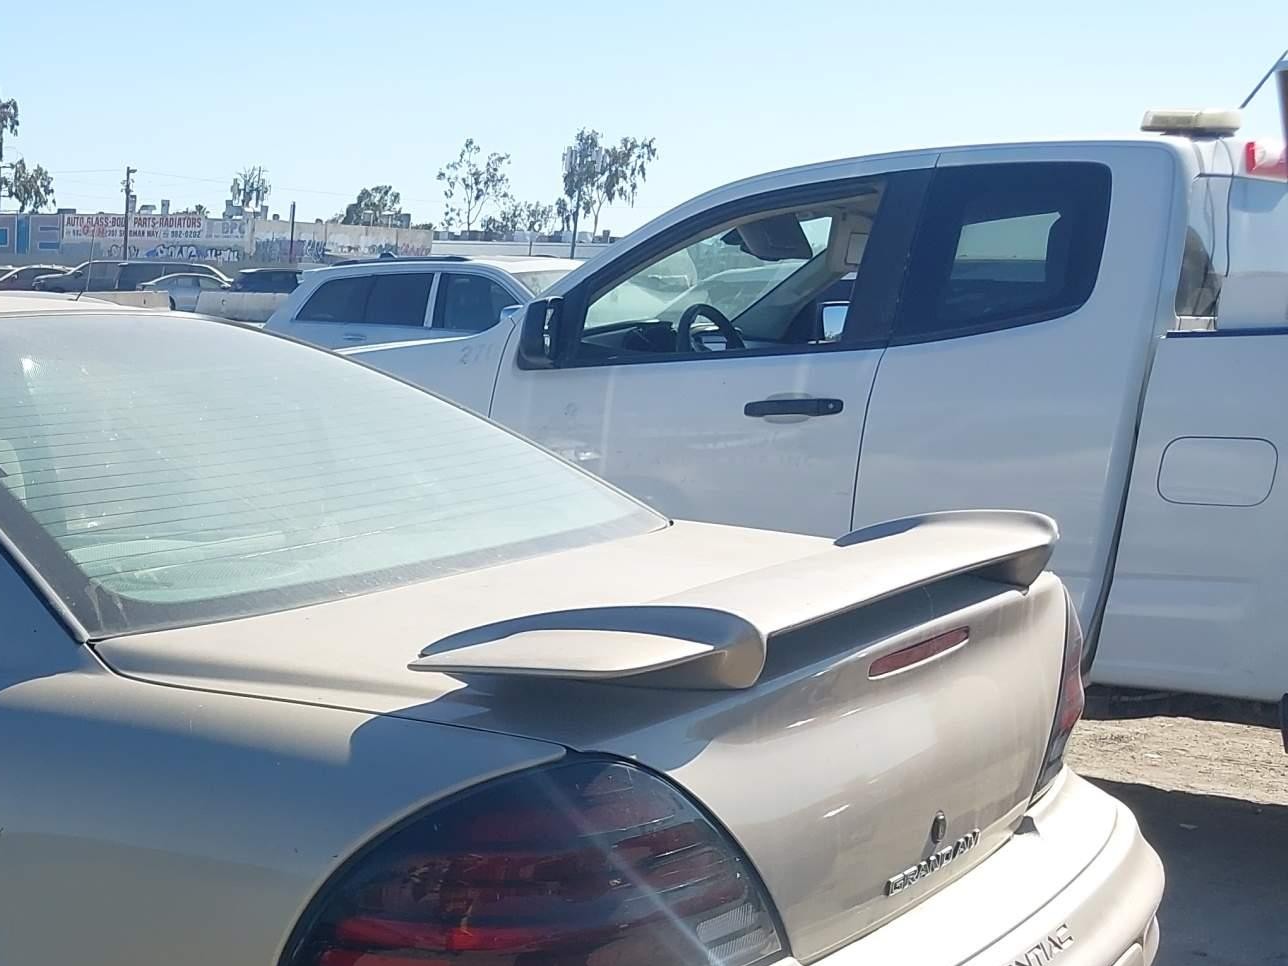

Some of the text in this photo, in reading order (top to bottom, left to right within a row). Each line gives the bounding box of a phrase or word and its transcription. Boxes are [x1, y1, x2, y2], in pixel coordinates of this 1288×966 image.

[66, 216, 84, 227] AUTO
[888, 828, 981, 896] GRAND AM
